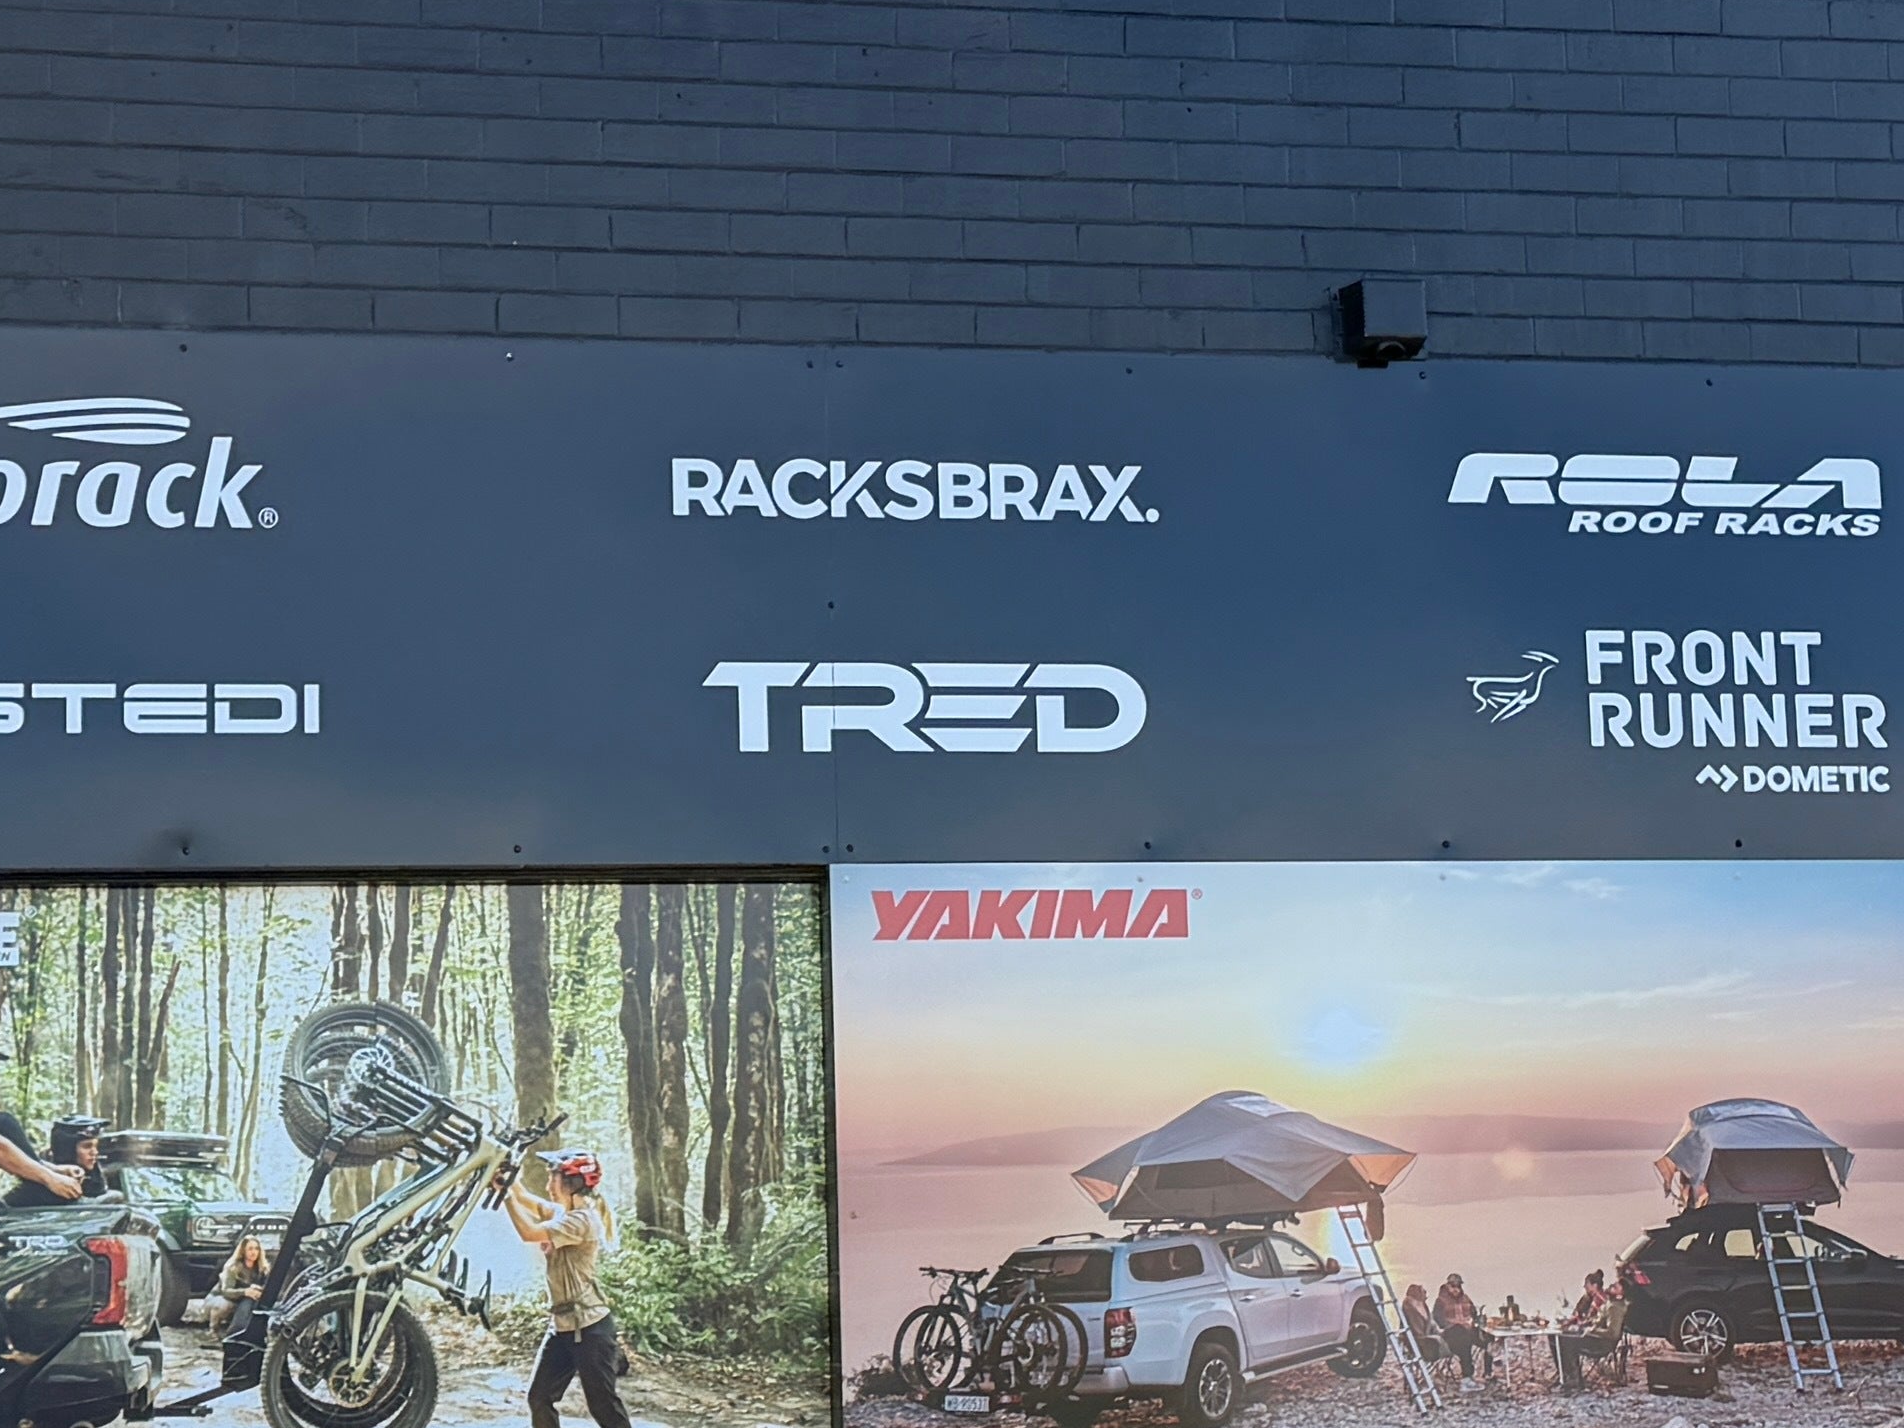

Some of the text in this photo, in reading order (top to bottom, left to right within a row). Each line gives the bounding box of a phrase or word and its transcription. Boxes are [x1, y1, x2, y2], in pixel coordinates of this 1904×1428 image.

[1447, 452, 1882, 510] ROLA
[1568, 510, 1881, 537] ROOF RACKS
[1585, 629, 1822, 687] FRONT
[702, 661, 1147, 753] TRED
[1588, 692, 1888, 749] RUNNER
[1742, 765, 1891, 793] DOMETIC
[870, 888, 1189, 941] YAKIMA
